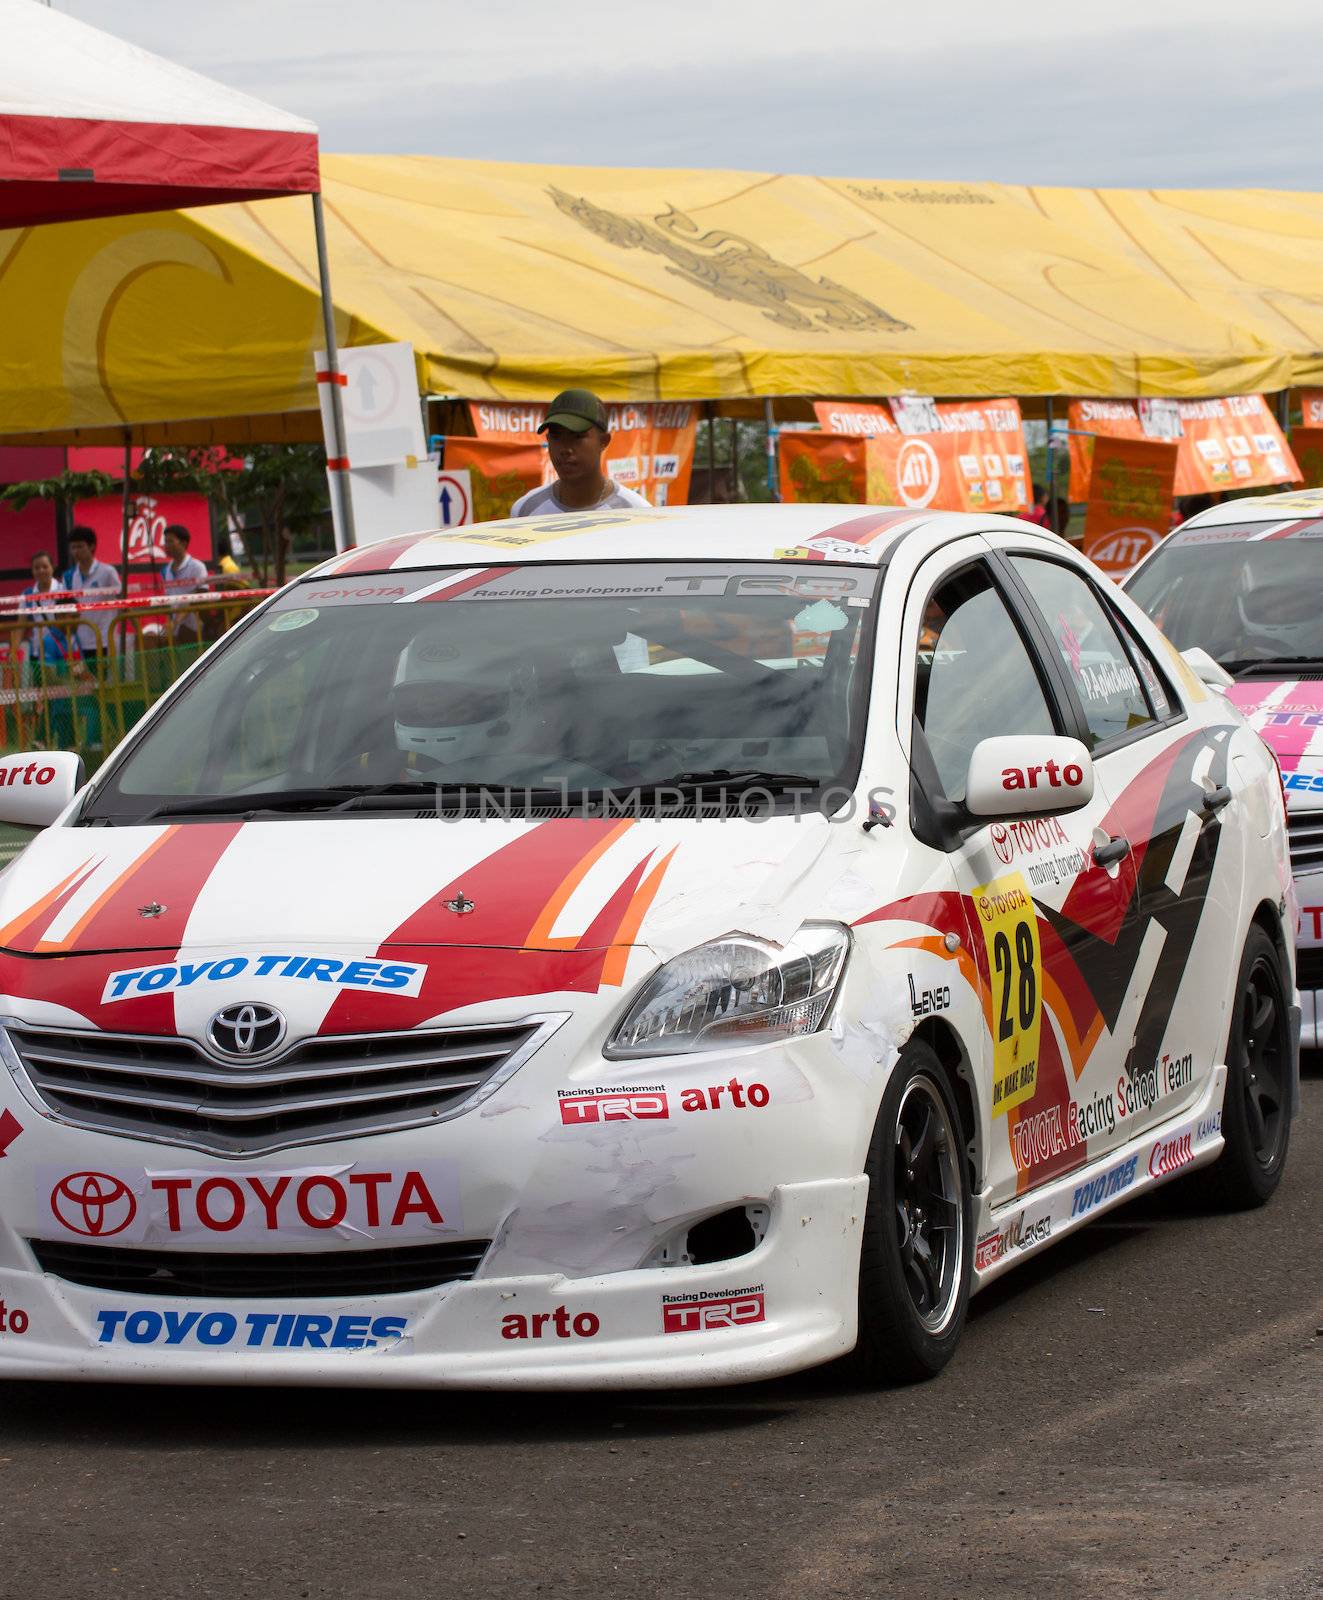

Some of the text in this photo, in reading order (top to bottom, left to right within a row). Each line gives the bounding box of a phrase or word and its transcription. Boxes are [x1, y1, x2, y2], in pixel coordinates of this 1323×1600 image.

[831, 412, 893, 434] SINGHA
[984, 409, 1019, 433] TEAM
[307, 586, 406, 600] TOYOTA
[473, 589, 538, 599] Racing
[541, 586, 664, 596] Development
[1001, 759, 1084, 790] arto
[1010, 817, 1070, 855] TOYOTA
[1028, 847, 1083, 886] moving forward
[991, 889, 1028, 915] TOYOTA
[111, 955, 418, 997] TOYO TIRES
[994, 921, 1037, 1043] 28
[557, 1083, 666, 1098] Racing Development
[680, 1077, 770, 1112] arto
[1004, 1070, 1018, 1098] MAKE
[562, 1095, 664, 1123] TRD
[1012, 1053, 1193, 1171] TOYOTA Racing School Team
[1148, 1132, 1194, 1180] Canon
[151, 1171, 445, 1232] TOYOTA
[1072, 1155, 1140, 1217] TOYO TIRES
[663, 1283, 764, 1303] Racing Development
[96, 1311, 409, 1348] TOYO TIRES
[501, 1304, 600, 1339] arto
[667, 1298, 760, 1330] TRD
